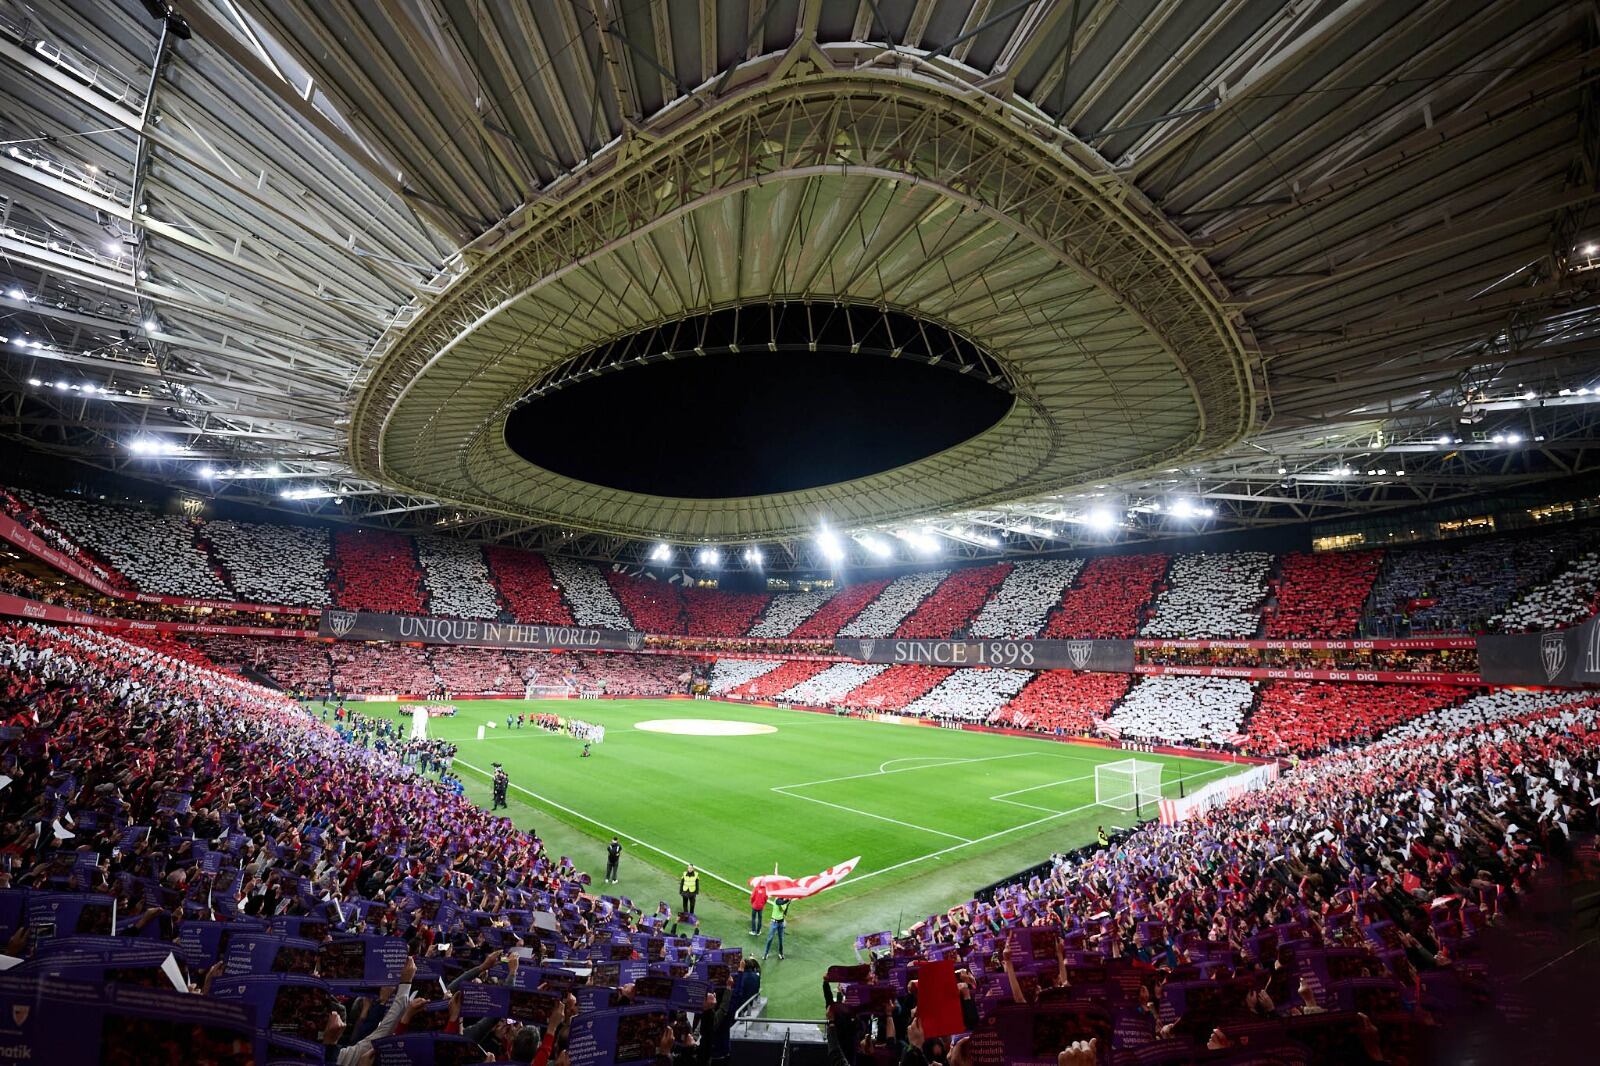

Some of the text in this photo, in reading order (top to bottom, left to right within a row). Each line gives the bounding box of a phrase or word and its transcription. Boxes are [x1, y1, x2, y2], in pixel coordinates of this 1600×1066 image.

[202, 601, 233, 609] ATHLETIC
[399, 616, 601, 646] UNIQUE IN THE WORLD
[1354, 641, 1374, 649] DIGI
[895, 641, 1035, 665] SINCE 1898
[1172, 667, 1202, 675] Petronor
[1268, 670, 1287, 678] DIGI
[1294, 671, 1314, 679] DIGI
[1329, 672, 1350, 680] DIGI
[1357, 673, 1378, 681] DIGI
